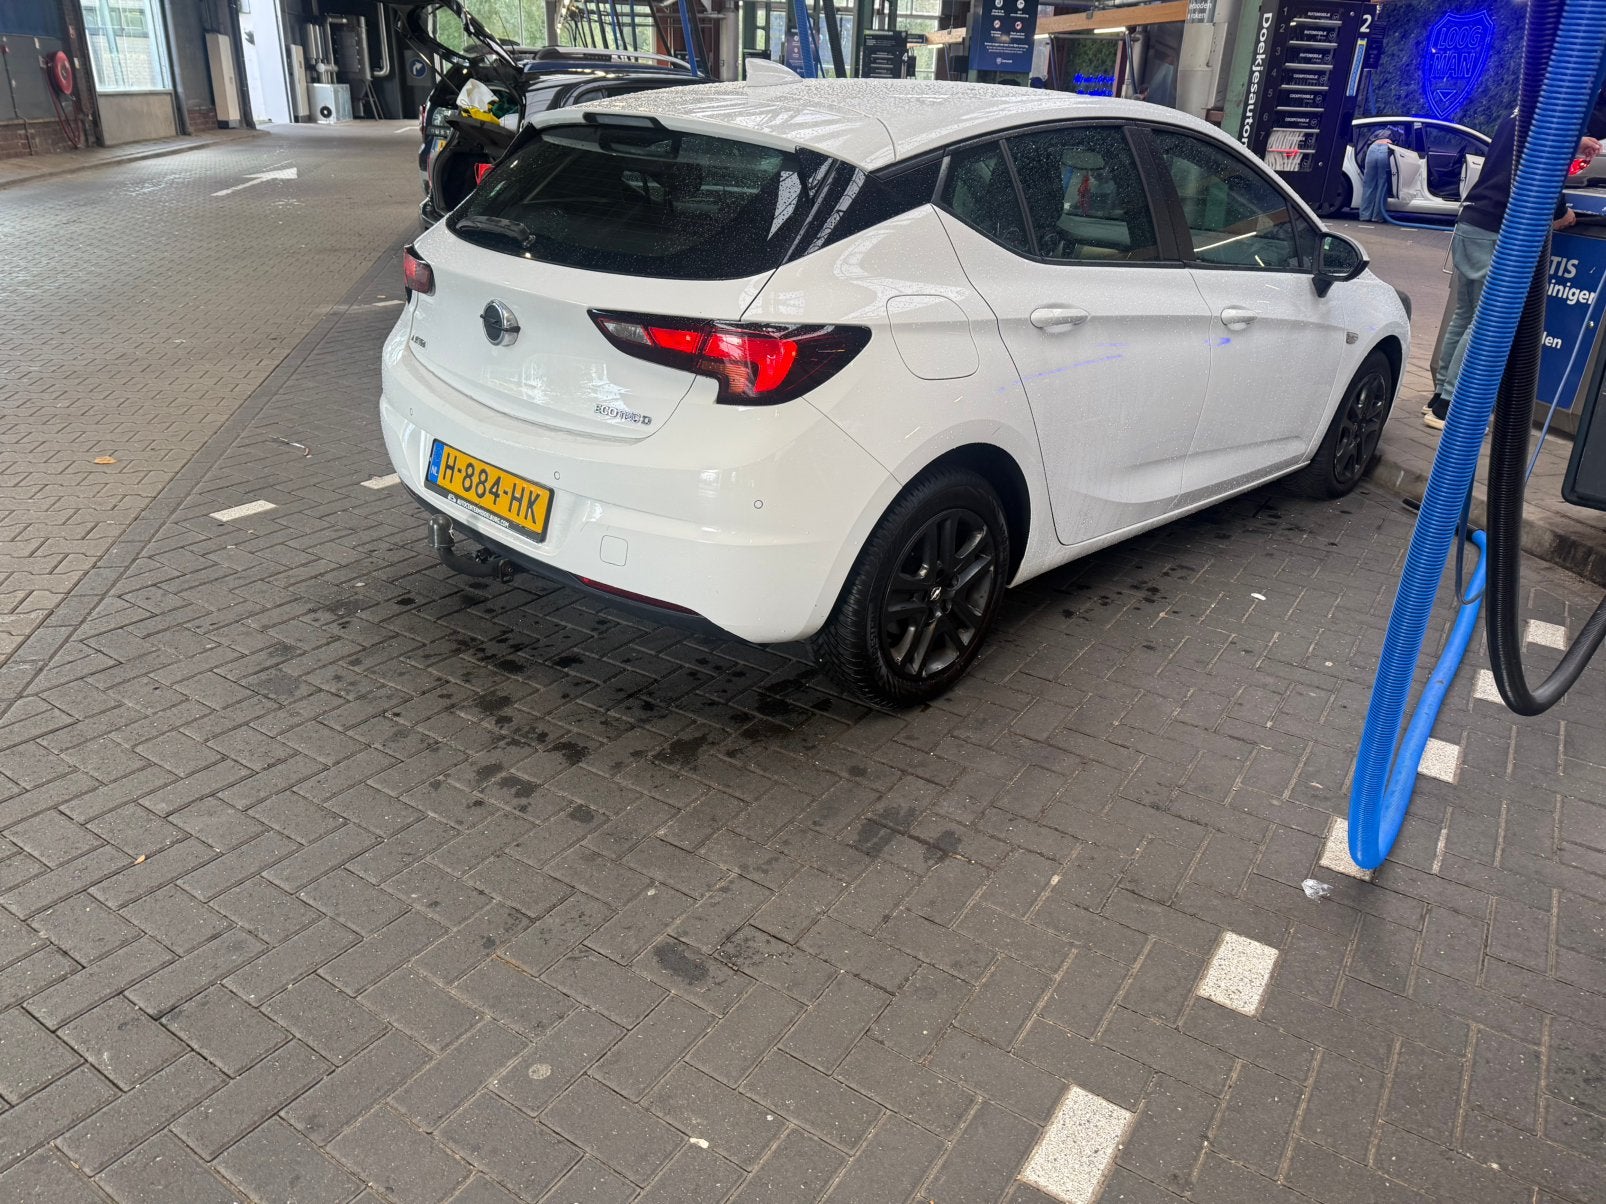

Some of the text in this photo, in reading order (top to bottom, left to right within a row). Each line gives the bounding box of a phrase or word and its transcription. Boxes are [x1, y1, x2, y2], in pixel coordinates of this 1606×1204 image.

[1280, 24, 1285, 33] 2
[1360, 14, 1372, 32] 2
[1438, 25, 1482, 48] LOOG
[1431, 53, 1475, 77] MAN
[1549, 255, 1579, 279] TIS
[430, 465, 438, 476] NL
[442, 451, 541, 525] H-884-HK
